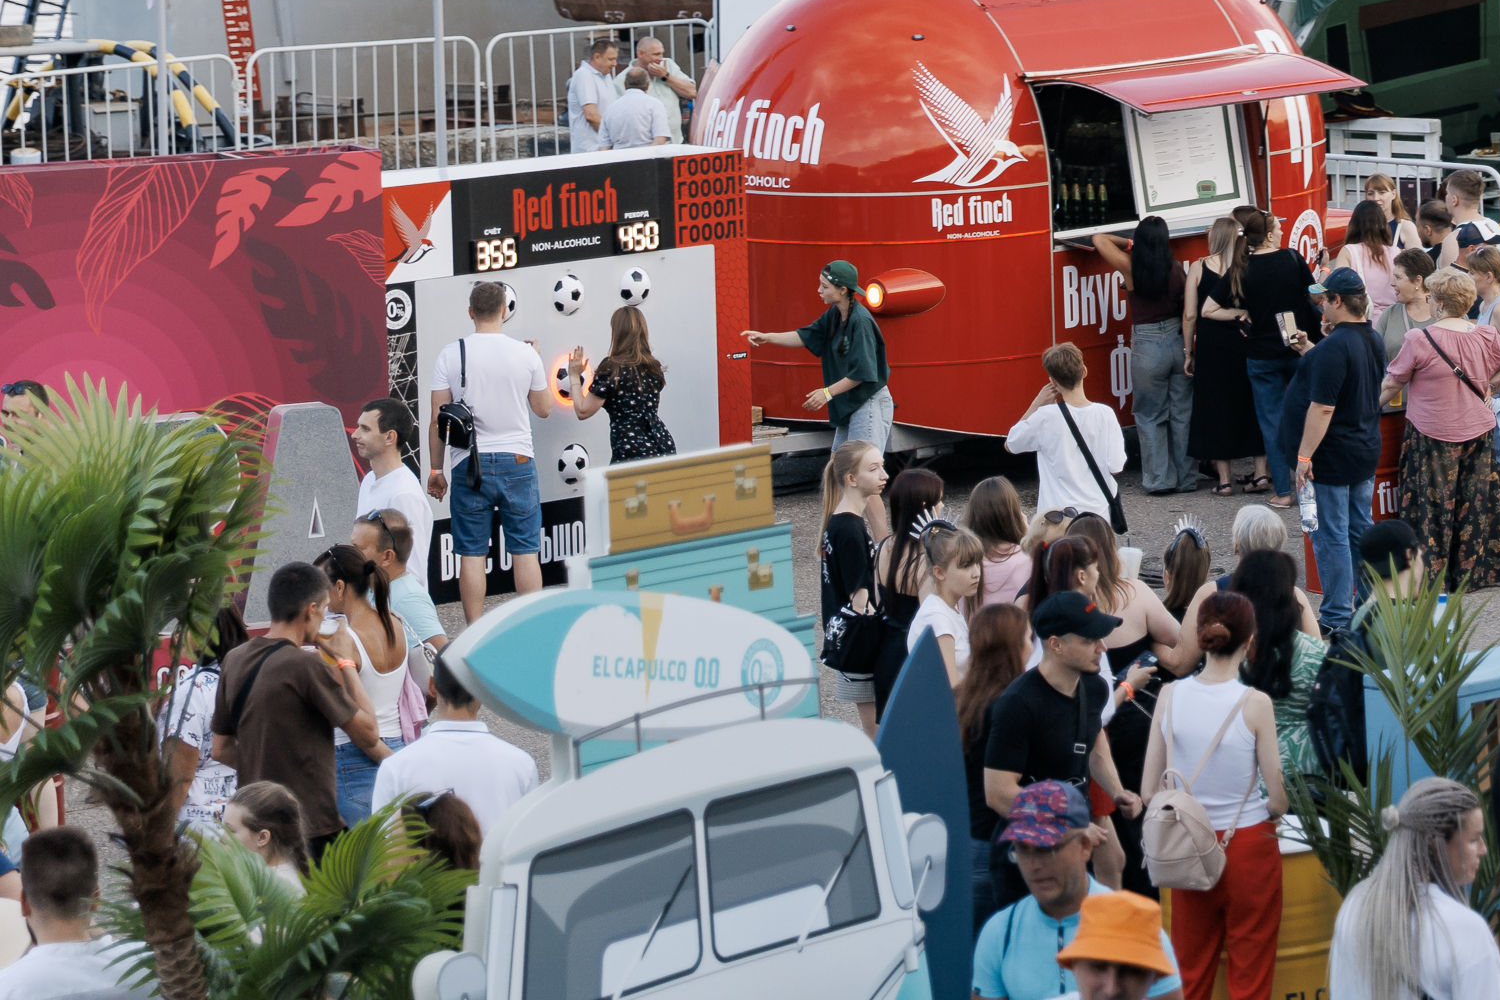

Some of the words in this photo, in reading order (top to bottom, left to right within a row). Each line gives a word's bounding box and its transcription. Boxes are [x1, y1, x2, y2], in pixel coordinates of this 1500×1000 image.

[703, 95, 745, 149] Red
[742, 99, 825, 165] finch
[677, 153, 743, 178] ГОООЛ!
[677, 175, 743, 200] ГОООЛ!
[512, 184, 553, 241] Red
[559, 177, 618, 228] finch
[624, 210, 649, 219] РЕКОРД
[678, 197, 744, 222] ГОООЛ!
[931, 195, 964, 232] Red
[968, 192, 1013, 225] finch
[484, 227, 501, 236] СЧЁТ
[532, 236, 601, 252] NON-ALCOHOLIC
[618, 221, 660, 252] 450
[678, 219, 744, 245] ГОООЛ!
[946, 230, 1000, 239] NON-ALCOHOLIC
[593, 655, 611, 678] EL
[614, 657, 687, 682] CAPULCO
